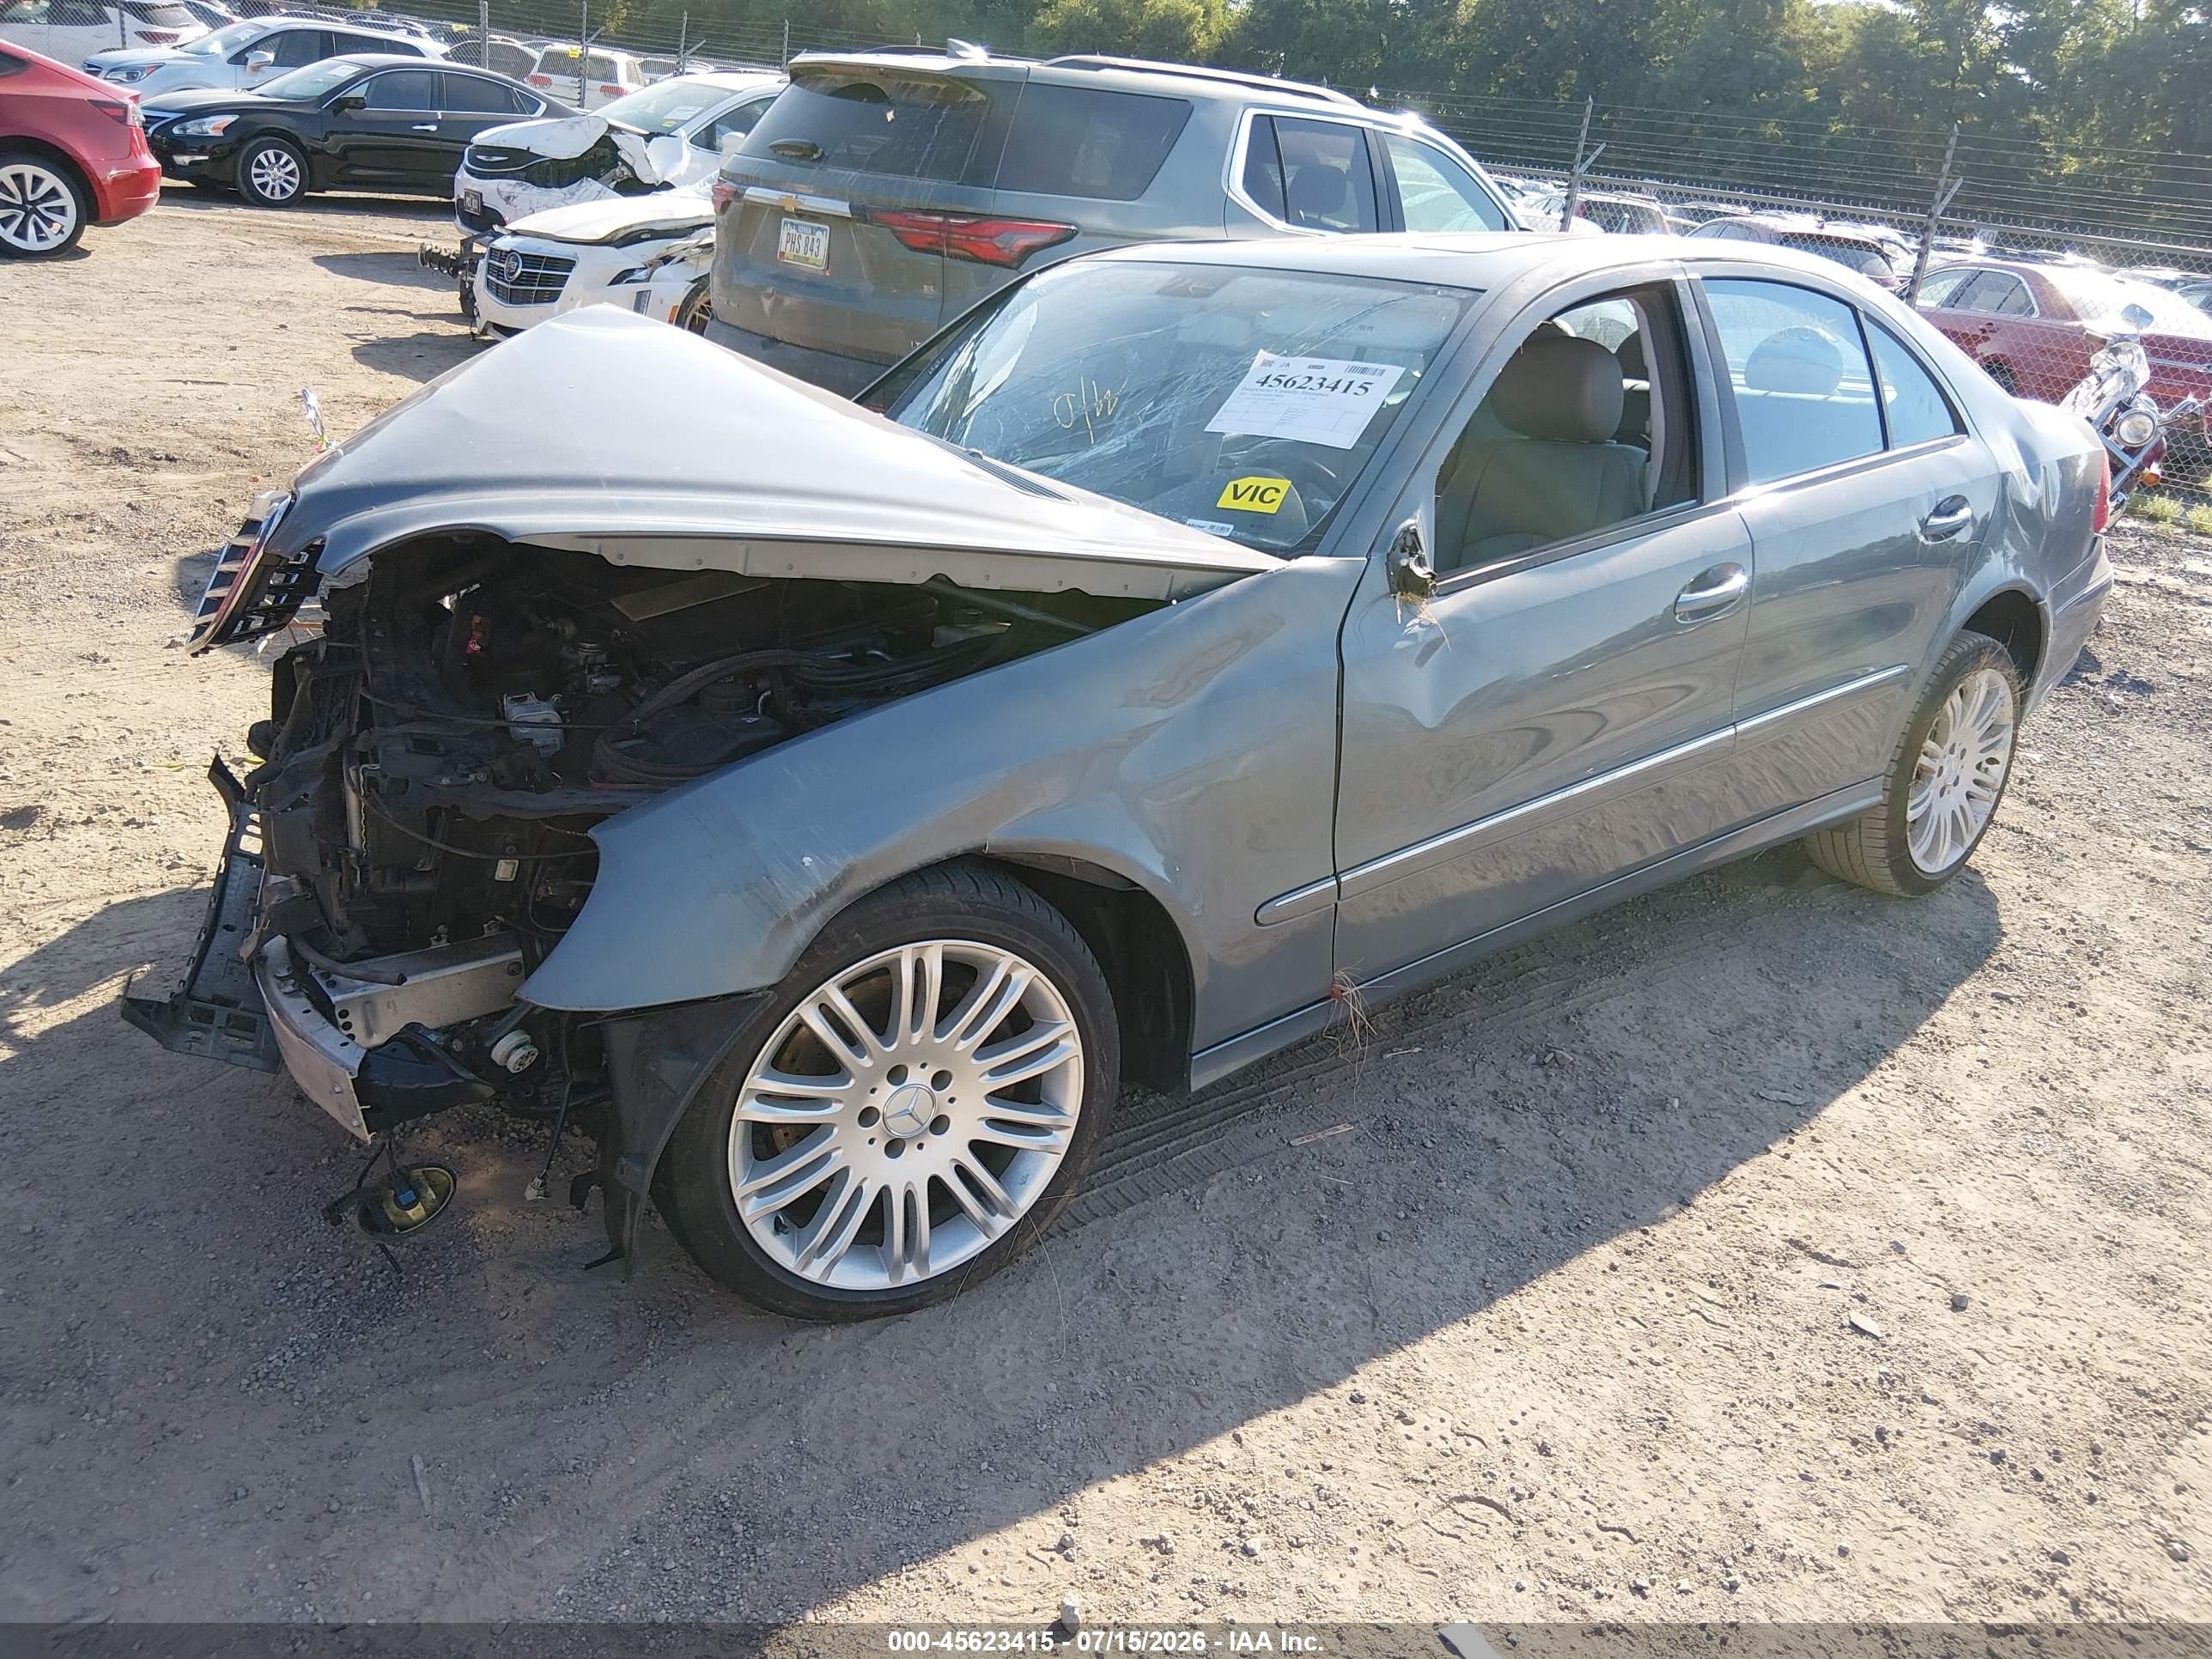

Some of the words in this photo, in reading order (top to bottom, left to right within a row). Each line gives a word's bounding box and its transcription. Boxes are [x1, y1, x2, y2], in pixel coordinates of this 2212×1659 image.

[798, 225, 812, 234] IOWA
[786, 232, 802, 254] PHS
[804, 236, 821, 258] 843
[1255, 373, 1374, 397] 45623415
[1231, 483, 1280, 505] VIC
